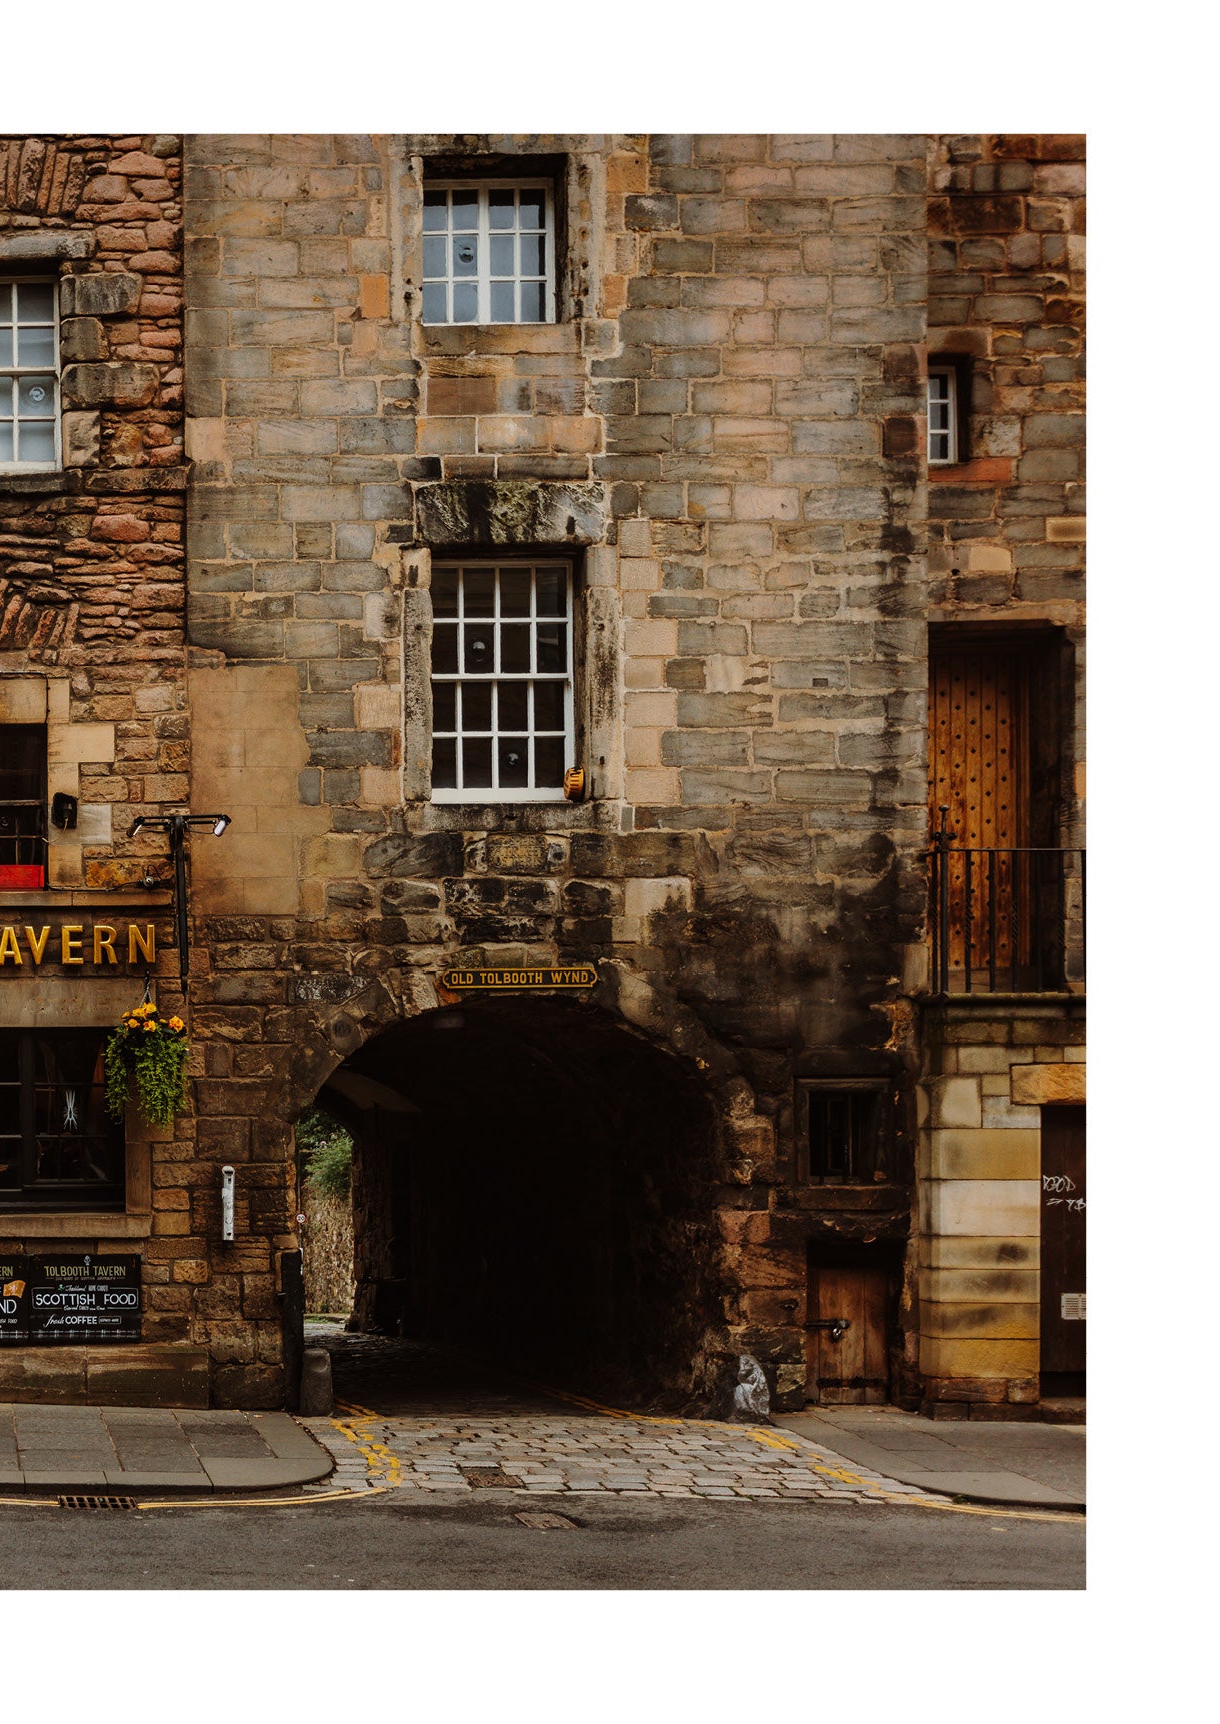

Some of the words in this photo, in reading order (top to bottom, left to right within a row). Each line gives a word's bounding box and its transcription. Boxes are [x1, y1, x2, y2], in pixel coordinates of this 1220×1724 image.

[451, 973, 473, 984] OLD
[480, 972, 543, 984] TOLBOOTH
[551, 971, 588, 983] WYND
[44, 1265, 89, 1277] TOLBOOTH
[93, 1265, 126, 1277] TAVERN
[35, 1293, 96, 1306] SCOTTISH
[104, 1293, 137, 1305] FOOD
[43, 1314, 64, 1328] fresh
[65, 1316, 98, 1325] COFFEE
